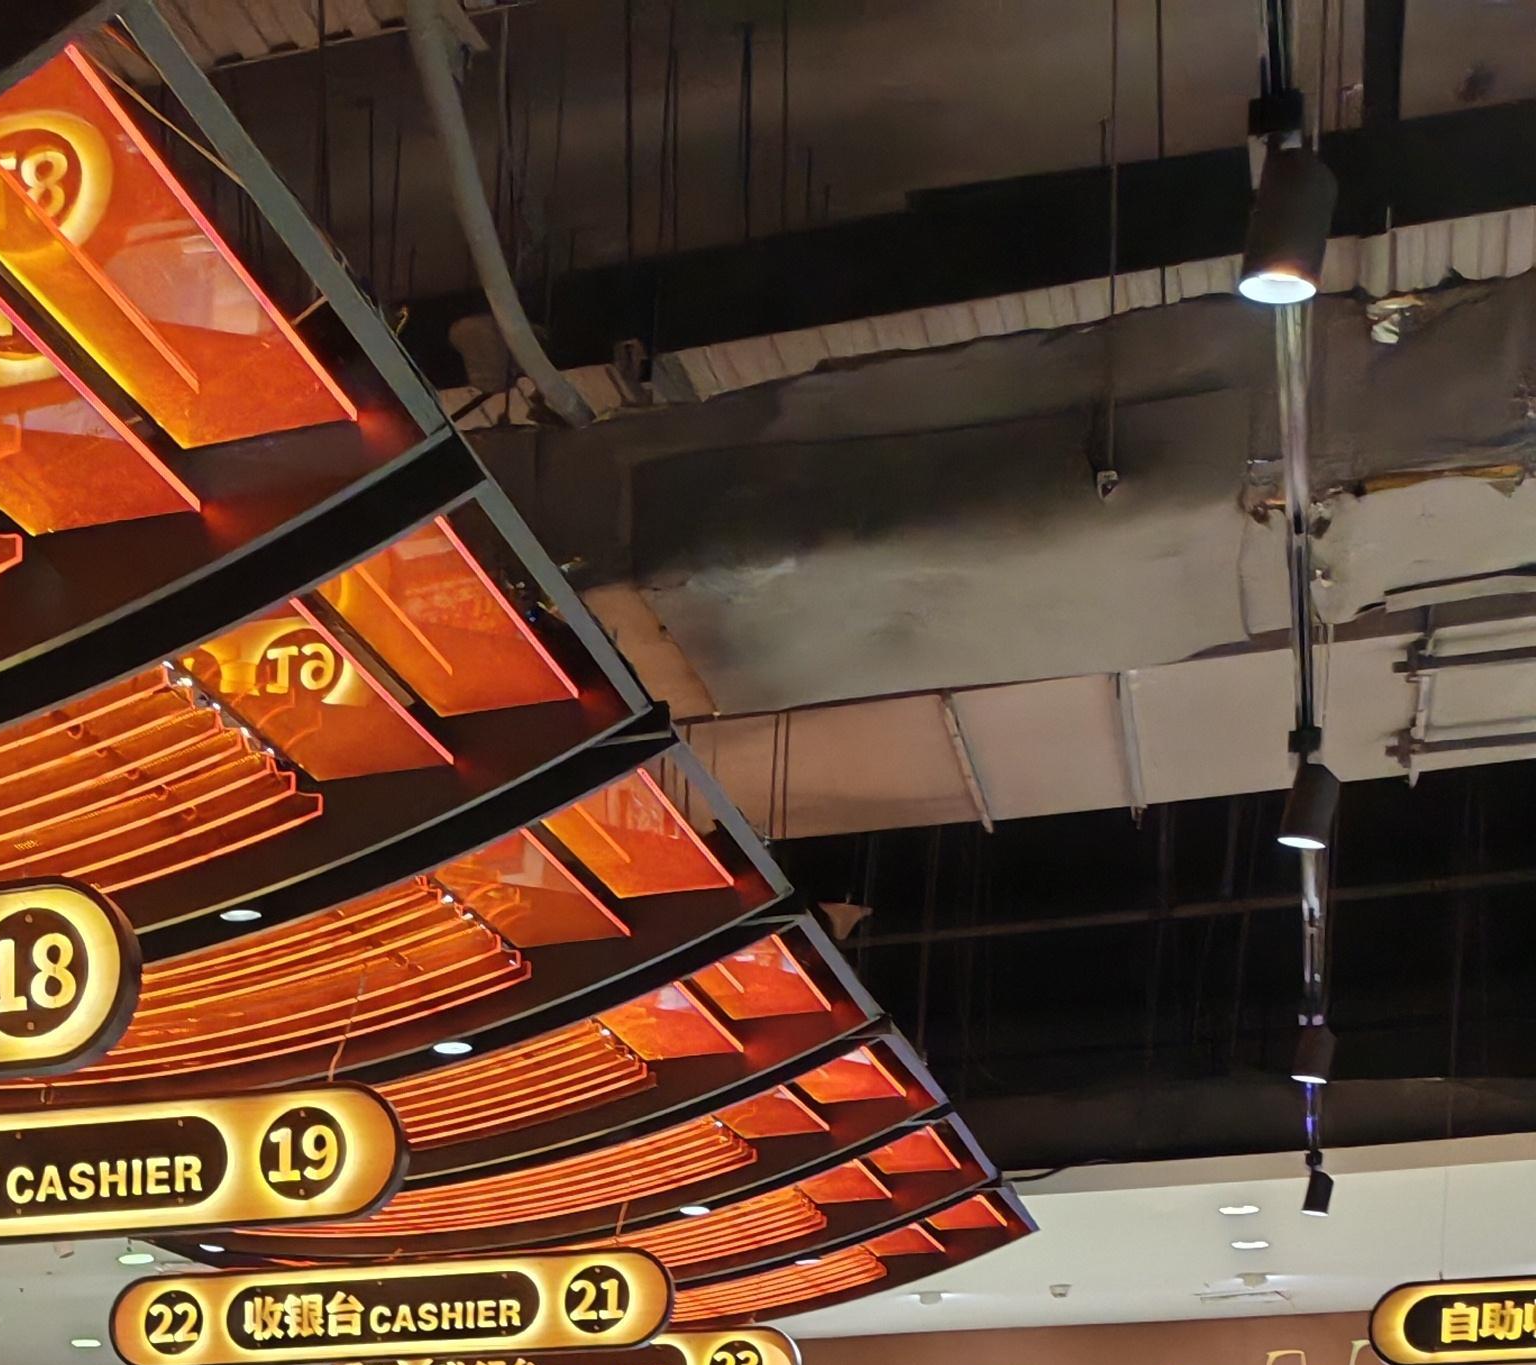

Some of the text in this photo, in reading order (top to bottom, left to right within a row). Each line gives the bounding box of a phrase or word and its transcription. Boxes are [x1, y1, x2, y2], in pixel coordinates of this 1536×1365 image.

[6, 1154, 203, 1205] CASHIER
[267, 1123, 340, 1185] 19
[146, 1278, 629, 1346] 22 收银台 CASHIER 21
